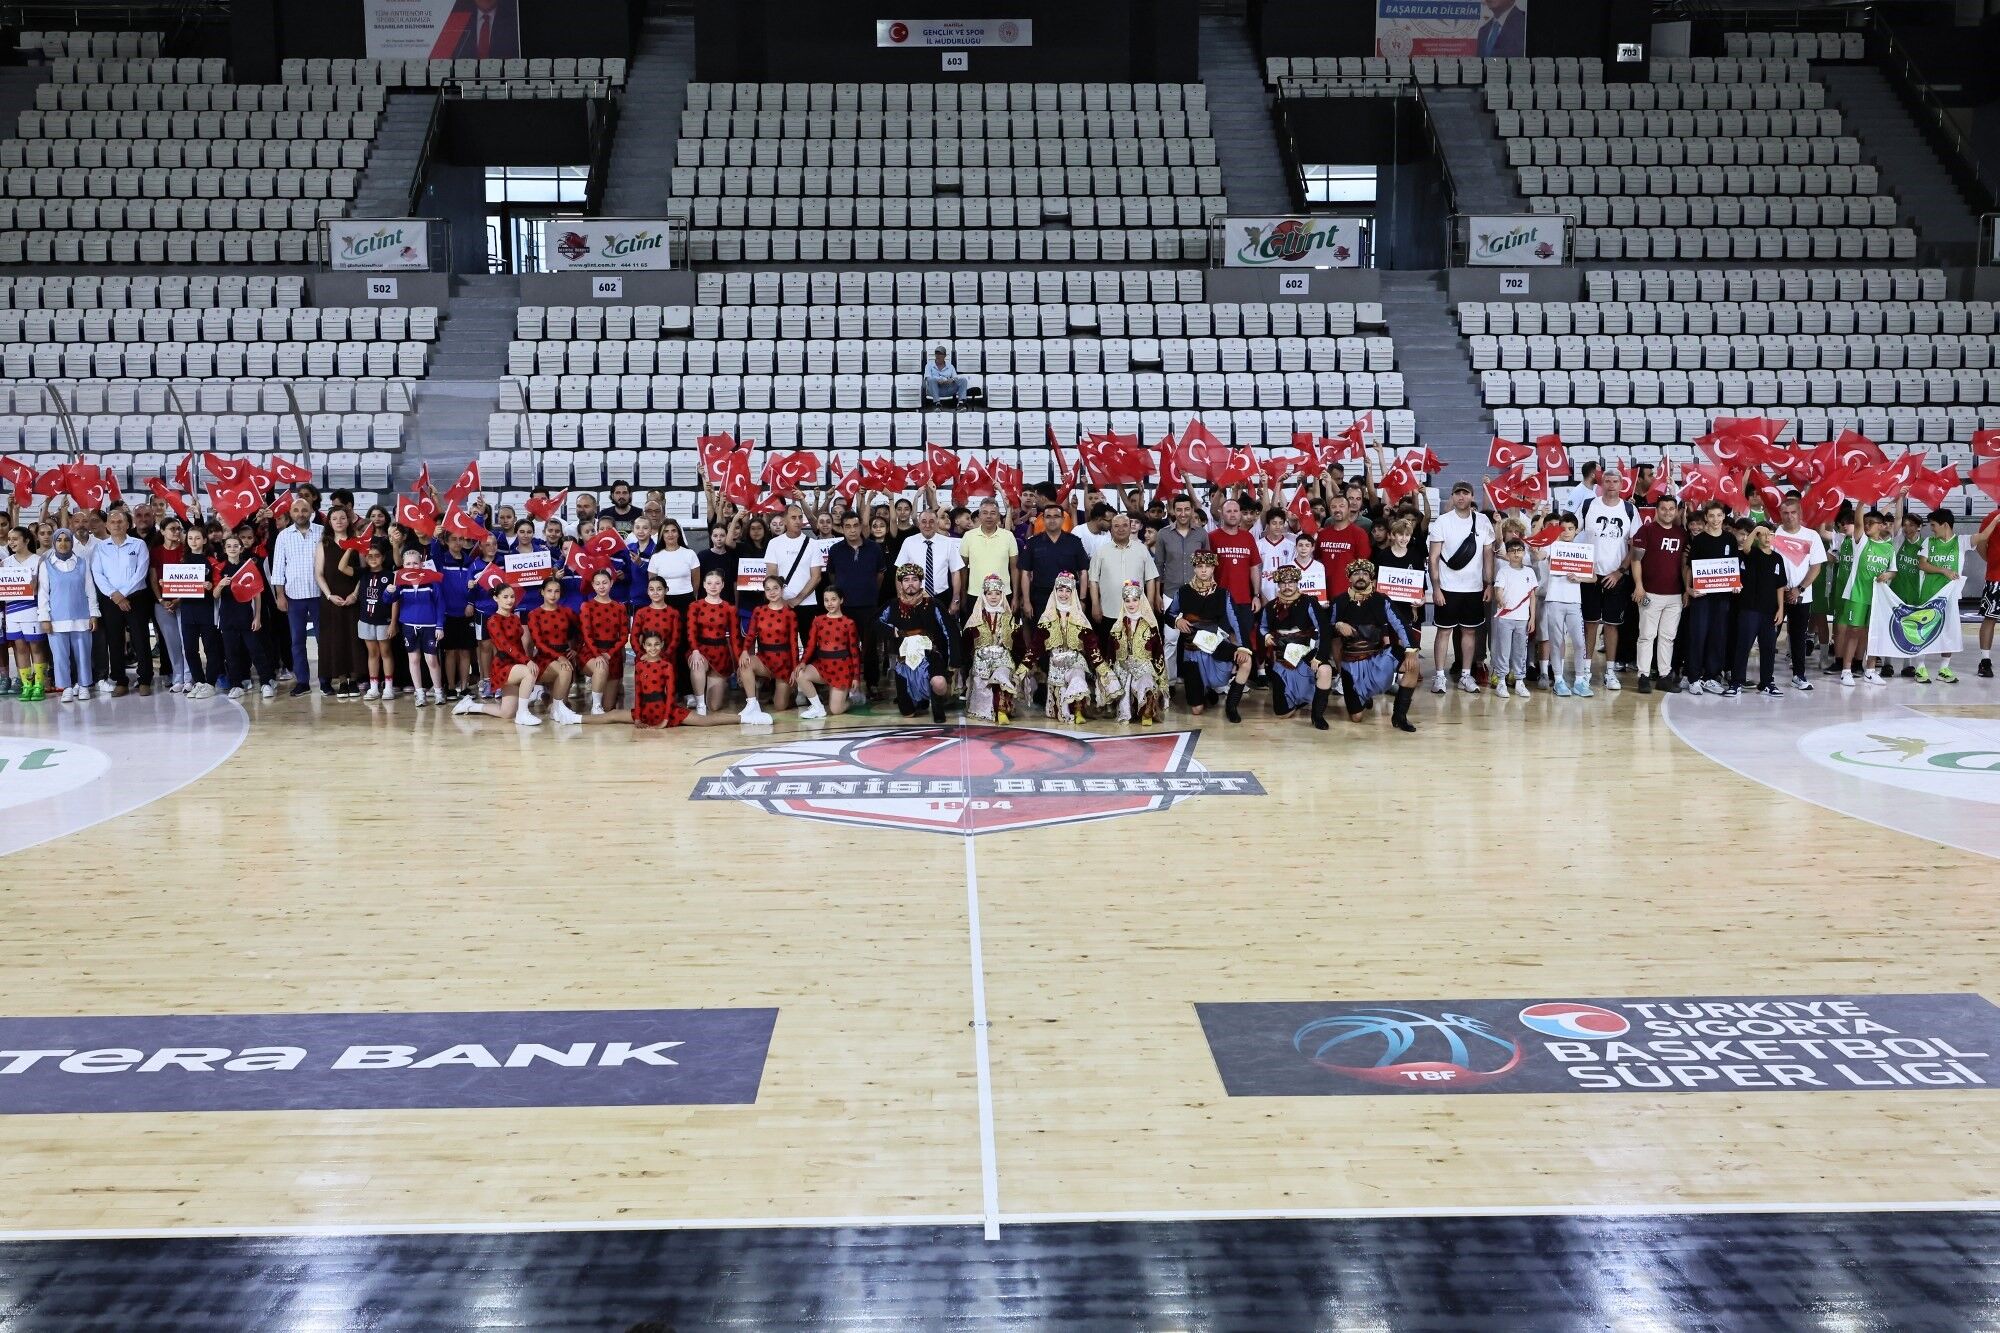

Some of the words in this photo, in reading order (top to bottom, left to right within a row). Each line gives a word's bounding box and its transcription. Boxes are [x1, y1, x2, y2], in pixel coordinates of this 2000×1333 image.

[1385, 5, 1438, 15] BAŞARILAR
[1622, 48, 1636, 56] 703
[947, 58, 962, 66] 603
[354, 228, 404, 256] Glint
[614, 231, 664, 255] Glint
[1260, 225, 1340, 258] Glint
[1489, 227, 1539, 253] Glint
[373, 284, 391, 293] 502
[598, 283, 616, 292] 602
[1286, 280, 1302, 288] 602
[1506, 280, 1523, 288] 702
[1661, 538, 1680, 553] AÇI
[1556, 550, 1588, 560] İSTANBUL
[512, 559, 544, 570] KOCAELİ
[1696, 566, 1735, 575] BALIKESİR
[1388, 574, 1412, 585] İZMİR
[702, 778, 967, 796] MANİSA
[994, 778, 1248, 793] BASKET
[928, 800, 1014, 810] 1994
[1622, 1002, 1870, 1019] TÜRKİYE
[1645, 1018, 1900, 1037] SİGORTA
[1544, 1038, 1990, 1062] BASKETBOL
[330, 1042, 686, 1070] BANK
[1400, 1070, 1456, 1080] TBF
[1568, 1062, 1829, 1088] SÜPER
[1832, 1060, 1987, 1086] LİGİ
